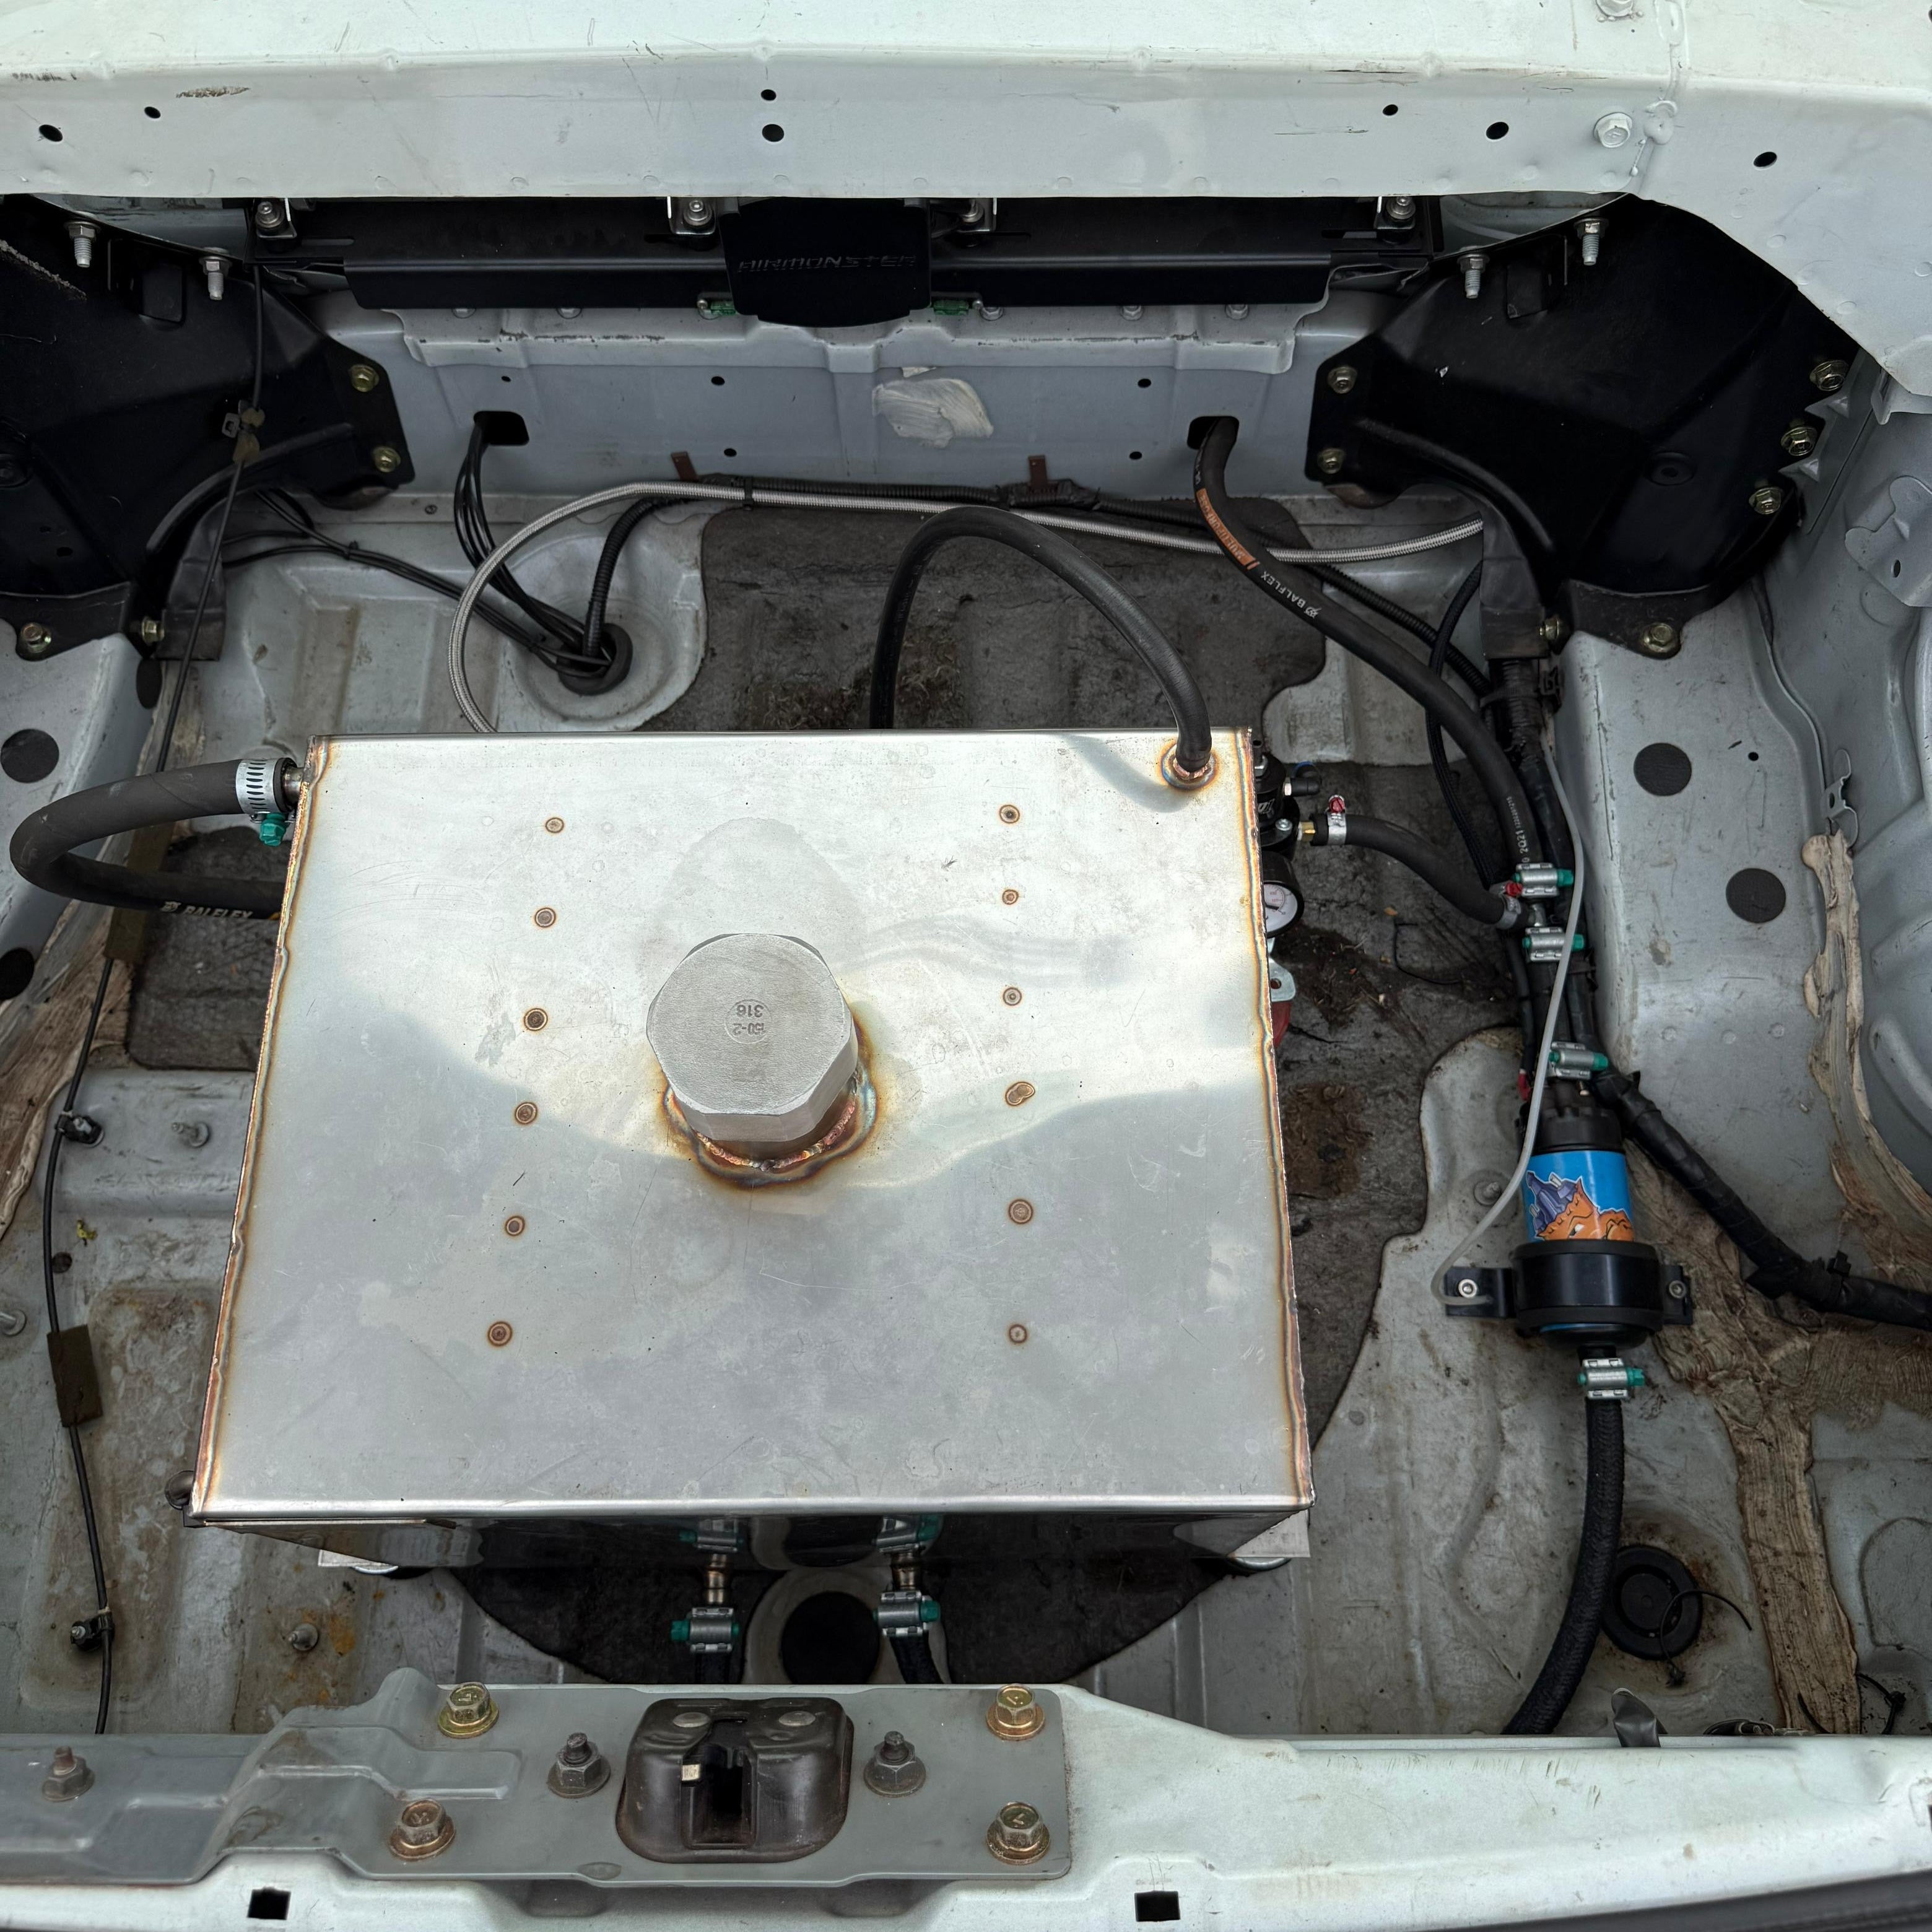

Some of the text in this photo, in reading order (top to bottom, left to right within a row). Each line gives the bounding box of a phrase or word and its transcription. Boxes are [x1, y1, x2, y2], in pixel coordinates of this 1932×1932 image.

[1199, 495, 1307, 609] BALFLEX MULTIPURPOSE
[736, 1004, 764, 1017] 316
